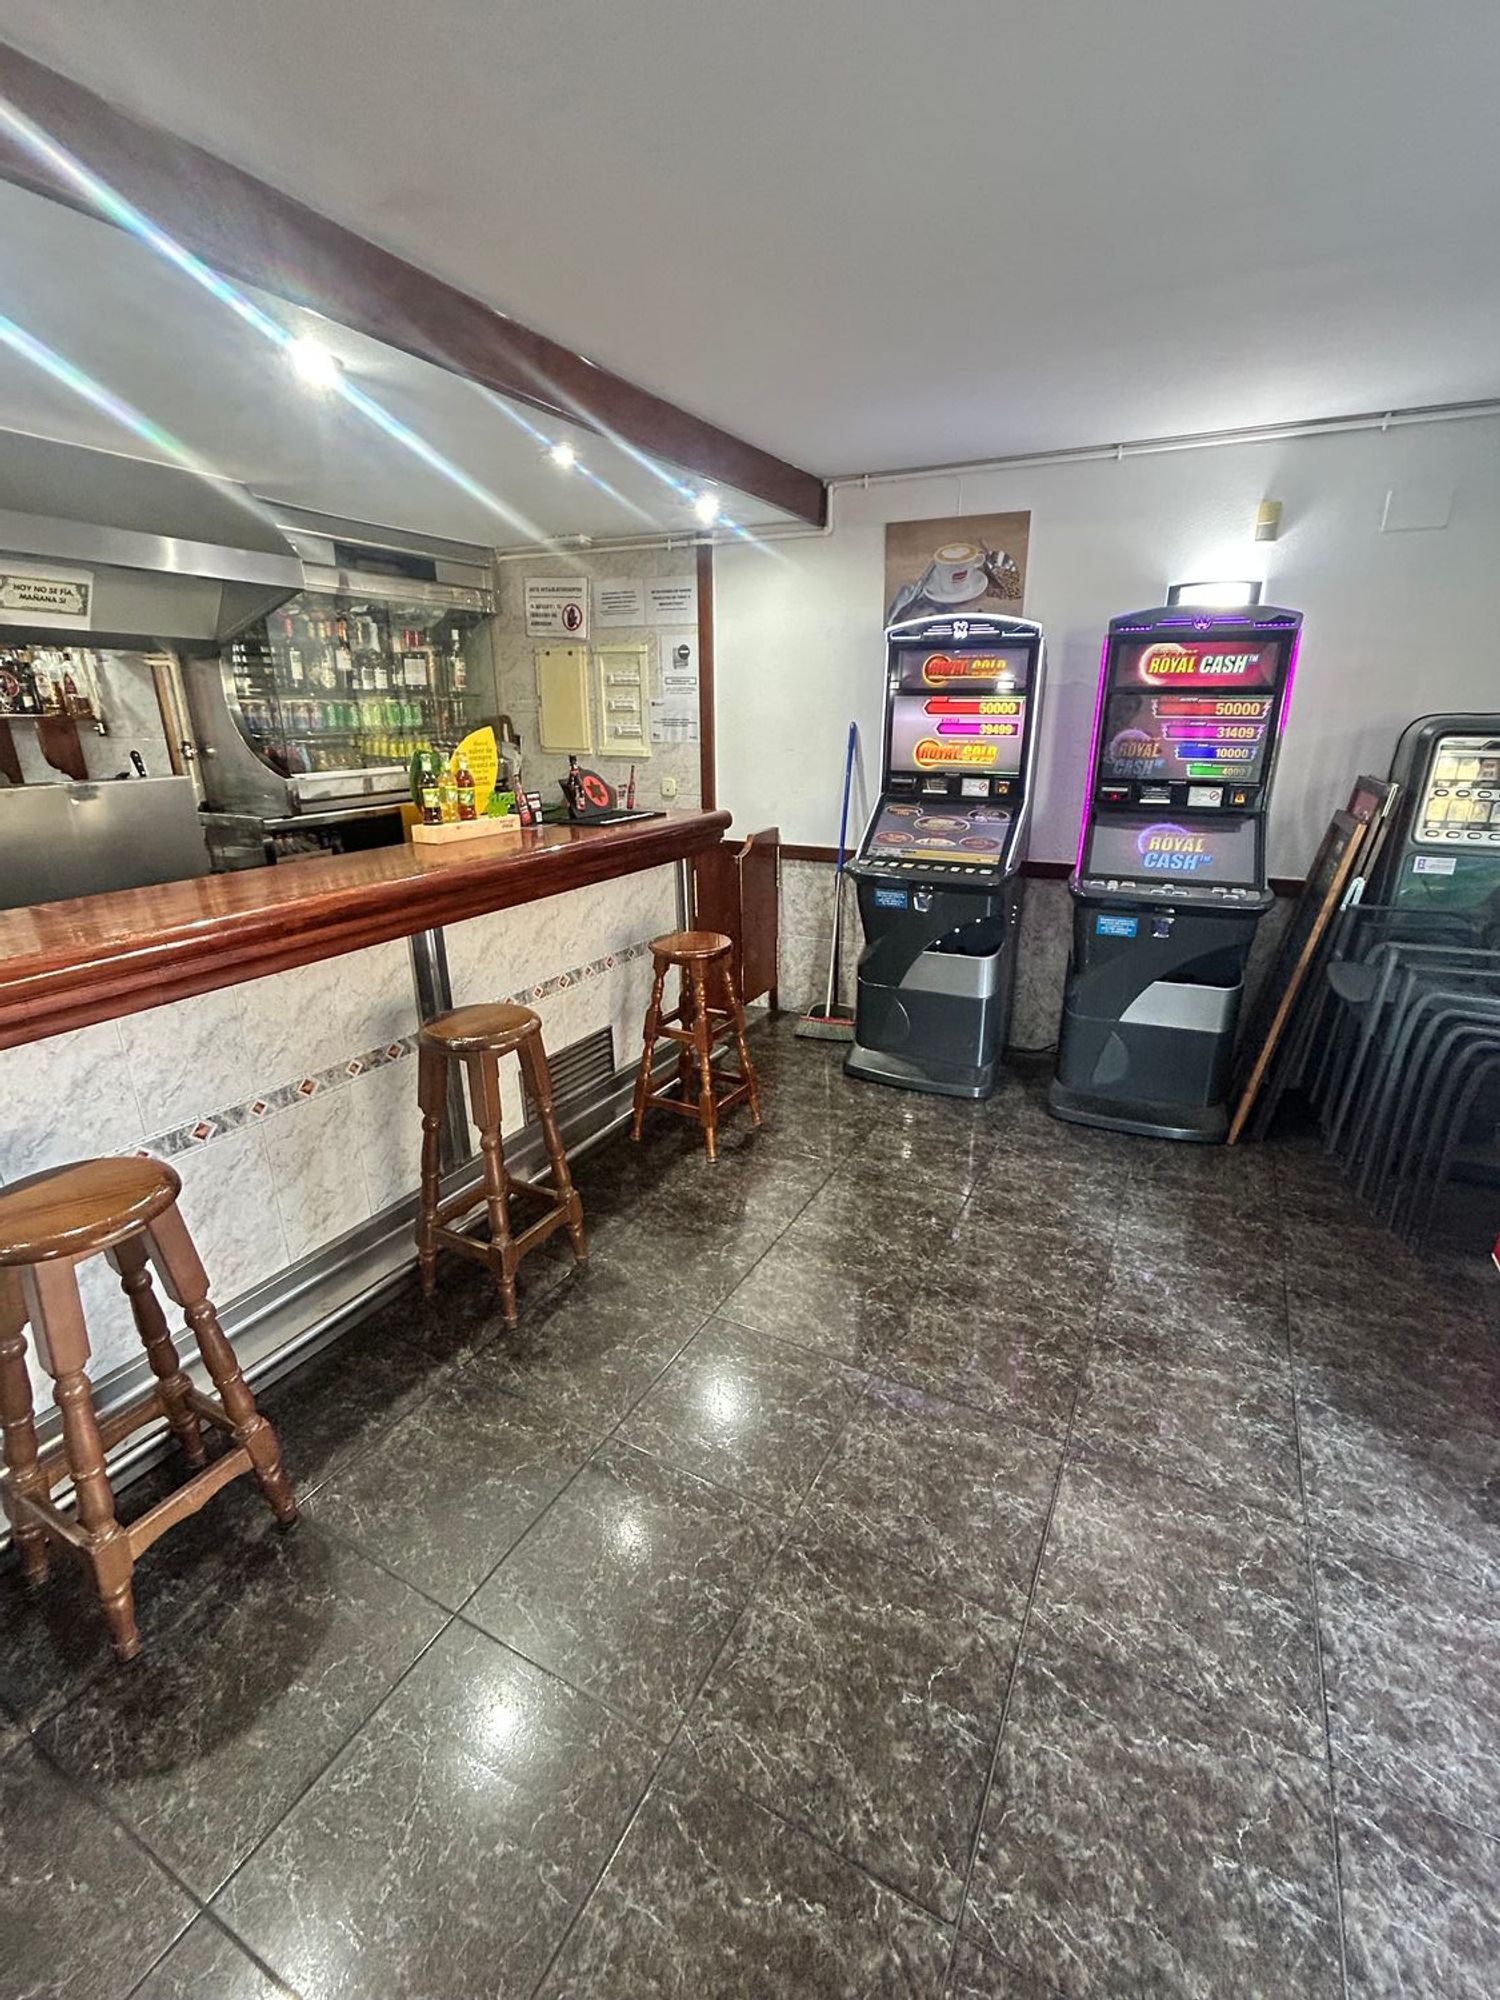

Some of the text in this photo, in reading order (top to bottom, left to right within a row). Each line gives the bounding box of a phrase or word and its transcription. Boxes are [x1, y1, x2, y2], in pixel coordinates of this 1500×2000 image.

[13, 583, 31, 591] HOY
[33, 585, 47, 593] NO
[1148, 656, 1197, 674] ROYAL
[978, 702, 1017, 715] 50000
[1215, 702, 1260, 715] 50000
[1216, 727, 1255, 739] 31409
[1215, 748, 1249, 758] 10000
[1148, 836, 1205, 853] ROYAL
